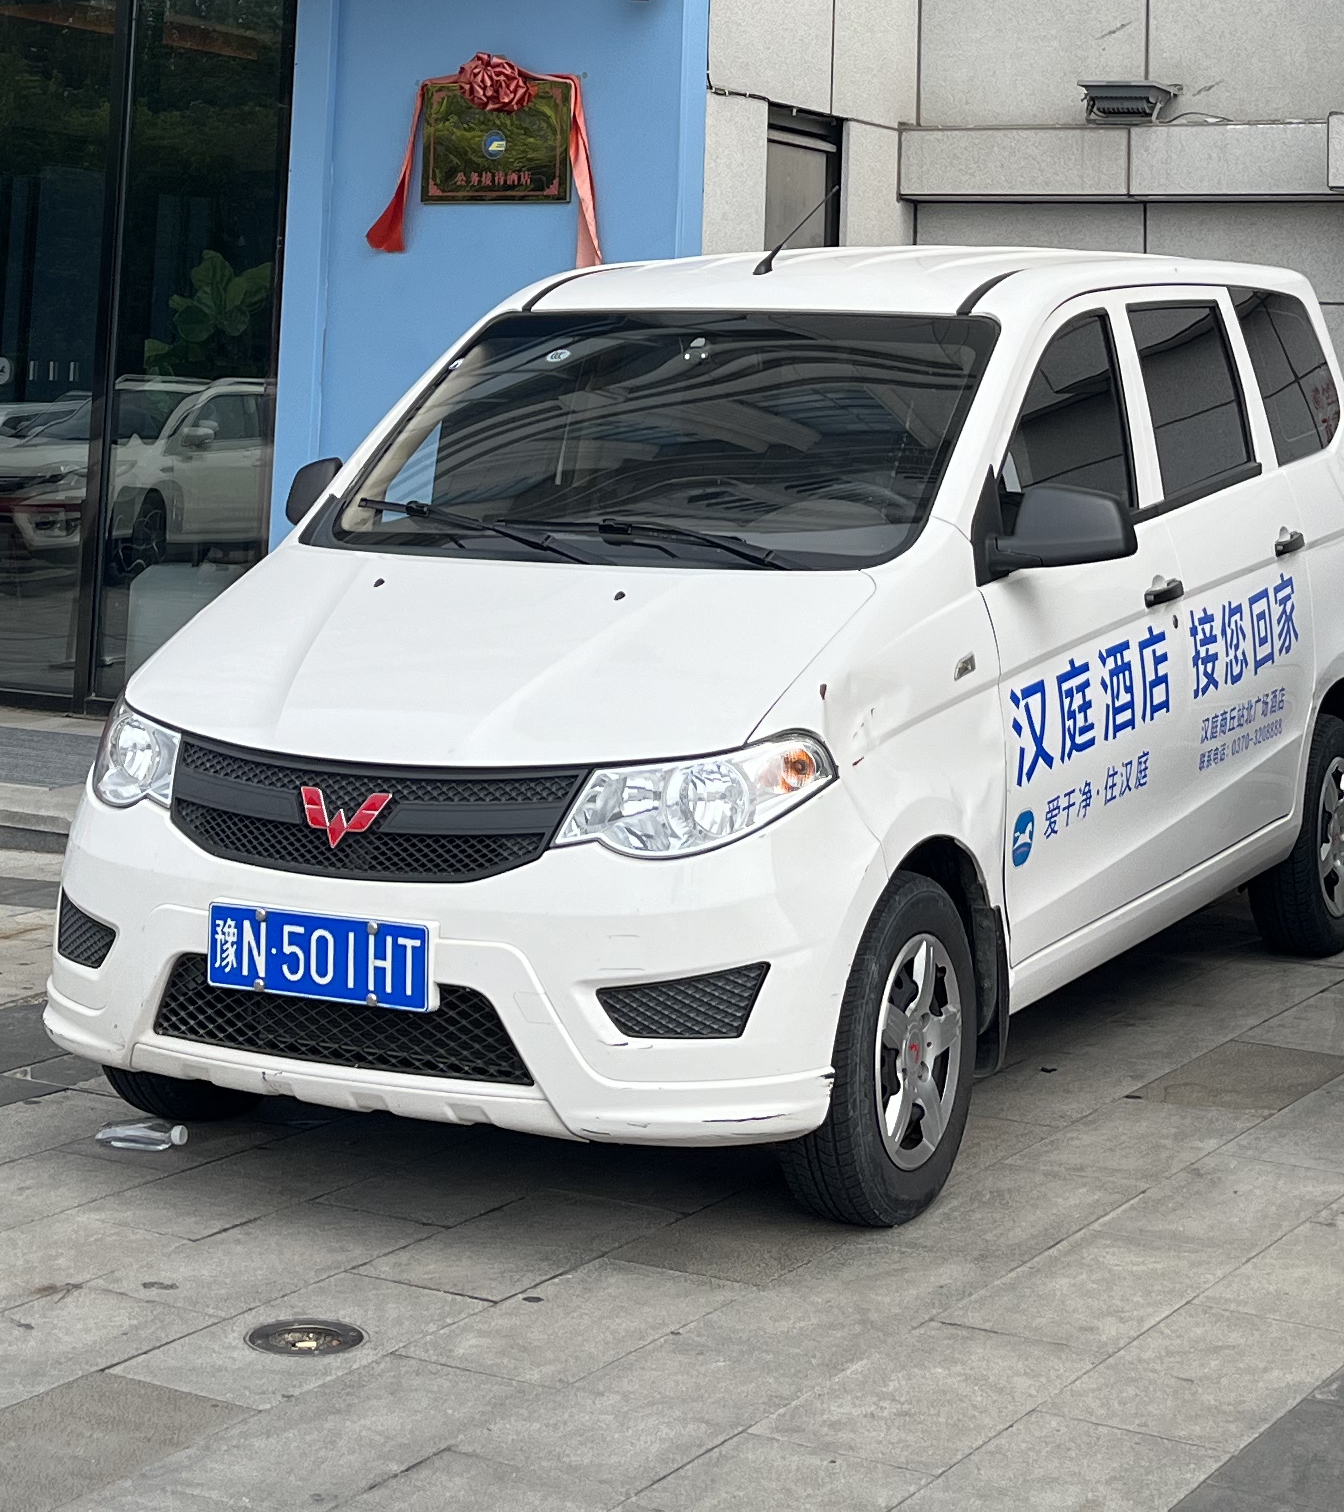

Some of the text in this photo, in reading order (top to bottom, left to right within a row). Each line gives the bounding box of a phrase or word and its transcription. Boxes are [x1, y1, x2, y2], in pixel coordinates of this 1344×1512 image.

[1009, 573, 1299, 787] 汉庭酒店 接您回家
